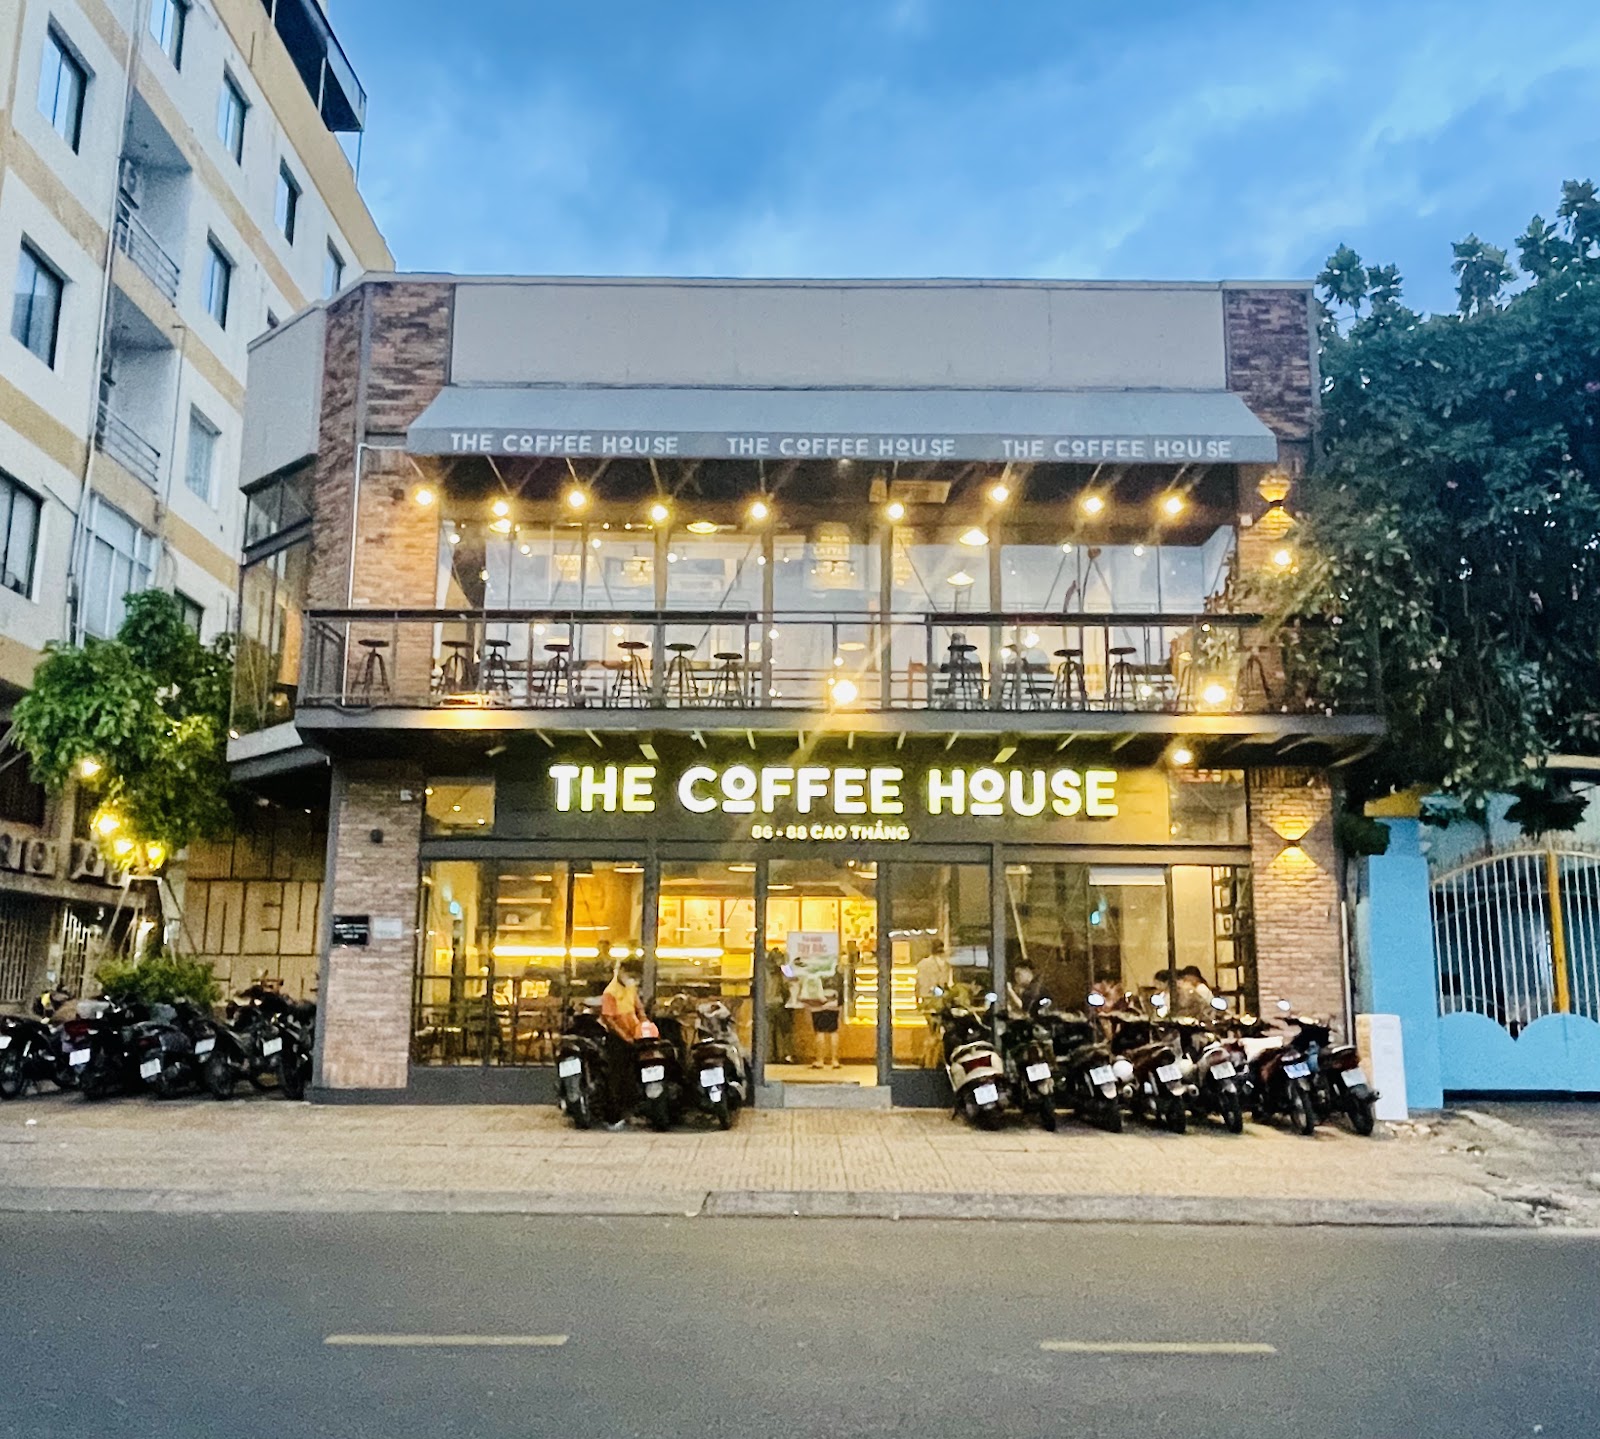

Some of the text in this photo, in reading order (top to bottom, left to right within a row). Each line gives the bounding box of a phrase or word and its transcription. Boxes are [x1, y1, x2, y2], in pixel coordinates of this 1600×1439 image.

[451, 433, 678, 453] THE COFFEE HOUSE
[727, 437, 955, 456] THE COFFEE HOUSE
[1002, 440, 1231, 458] THE COFFEE HOUSE
[549, 766, 1119, 816] THE COFFEE HOUSE
[810, 824, 847, 840] CAO
